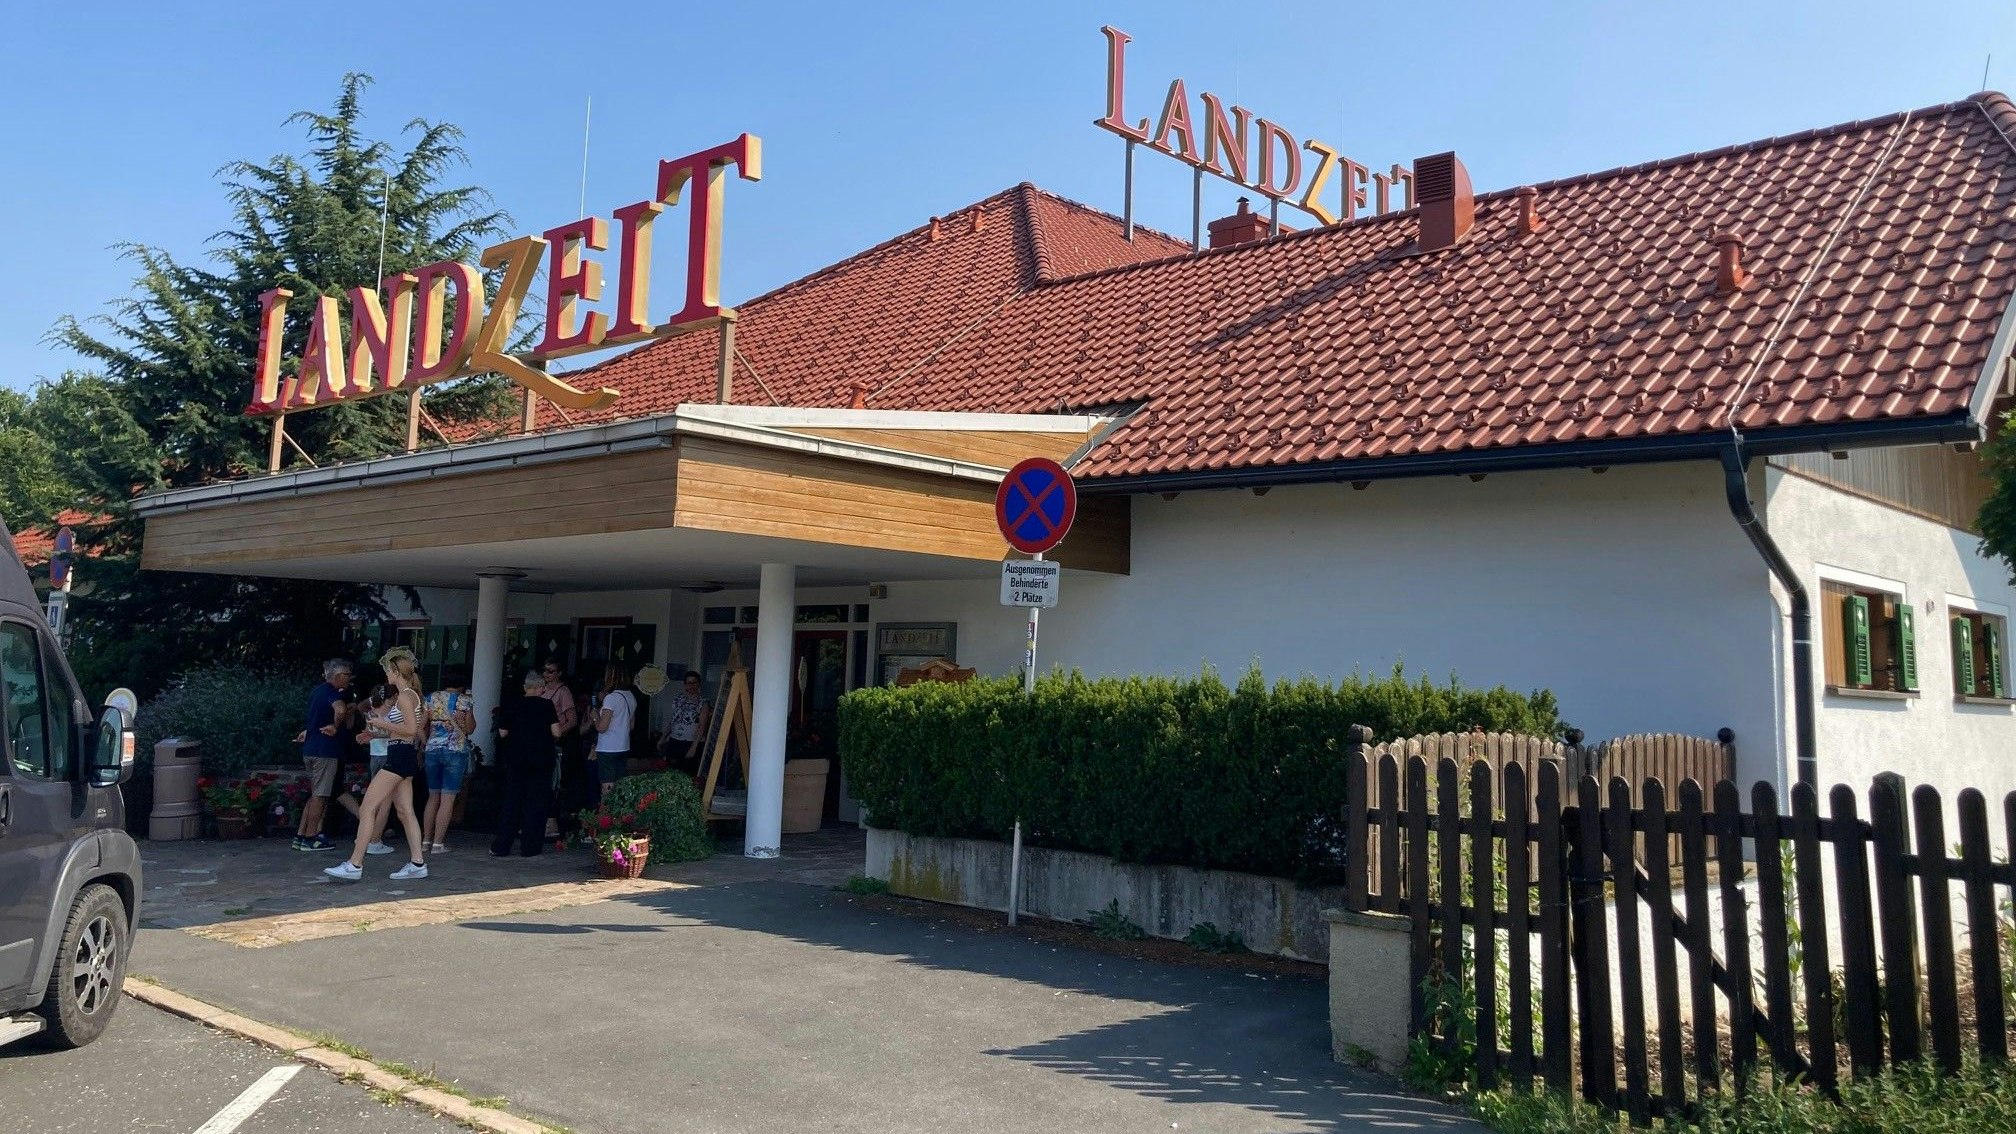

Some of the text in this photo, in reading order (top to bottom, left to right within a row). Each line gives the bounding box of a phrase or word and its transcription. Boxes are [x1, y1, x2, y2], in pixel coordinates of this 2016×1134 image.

[244, 132, 762, 415] LANDZEIT
[1005, 564, 1056, 576] Ausgenommen
[1010, 578, 1048, 589] Behinderte
[1014, 592, 1043, 602] 2 Plätze
